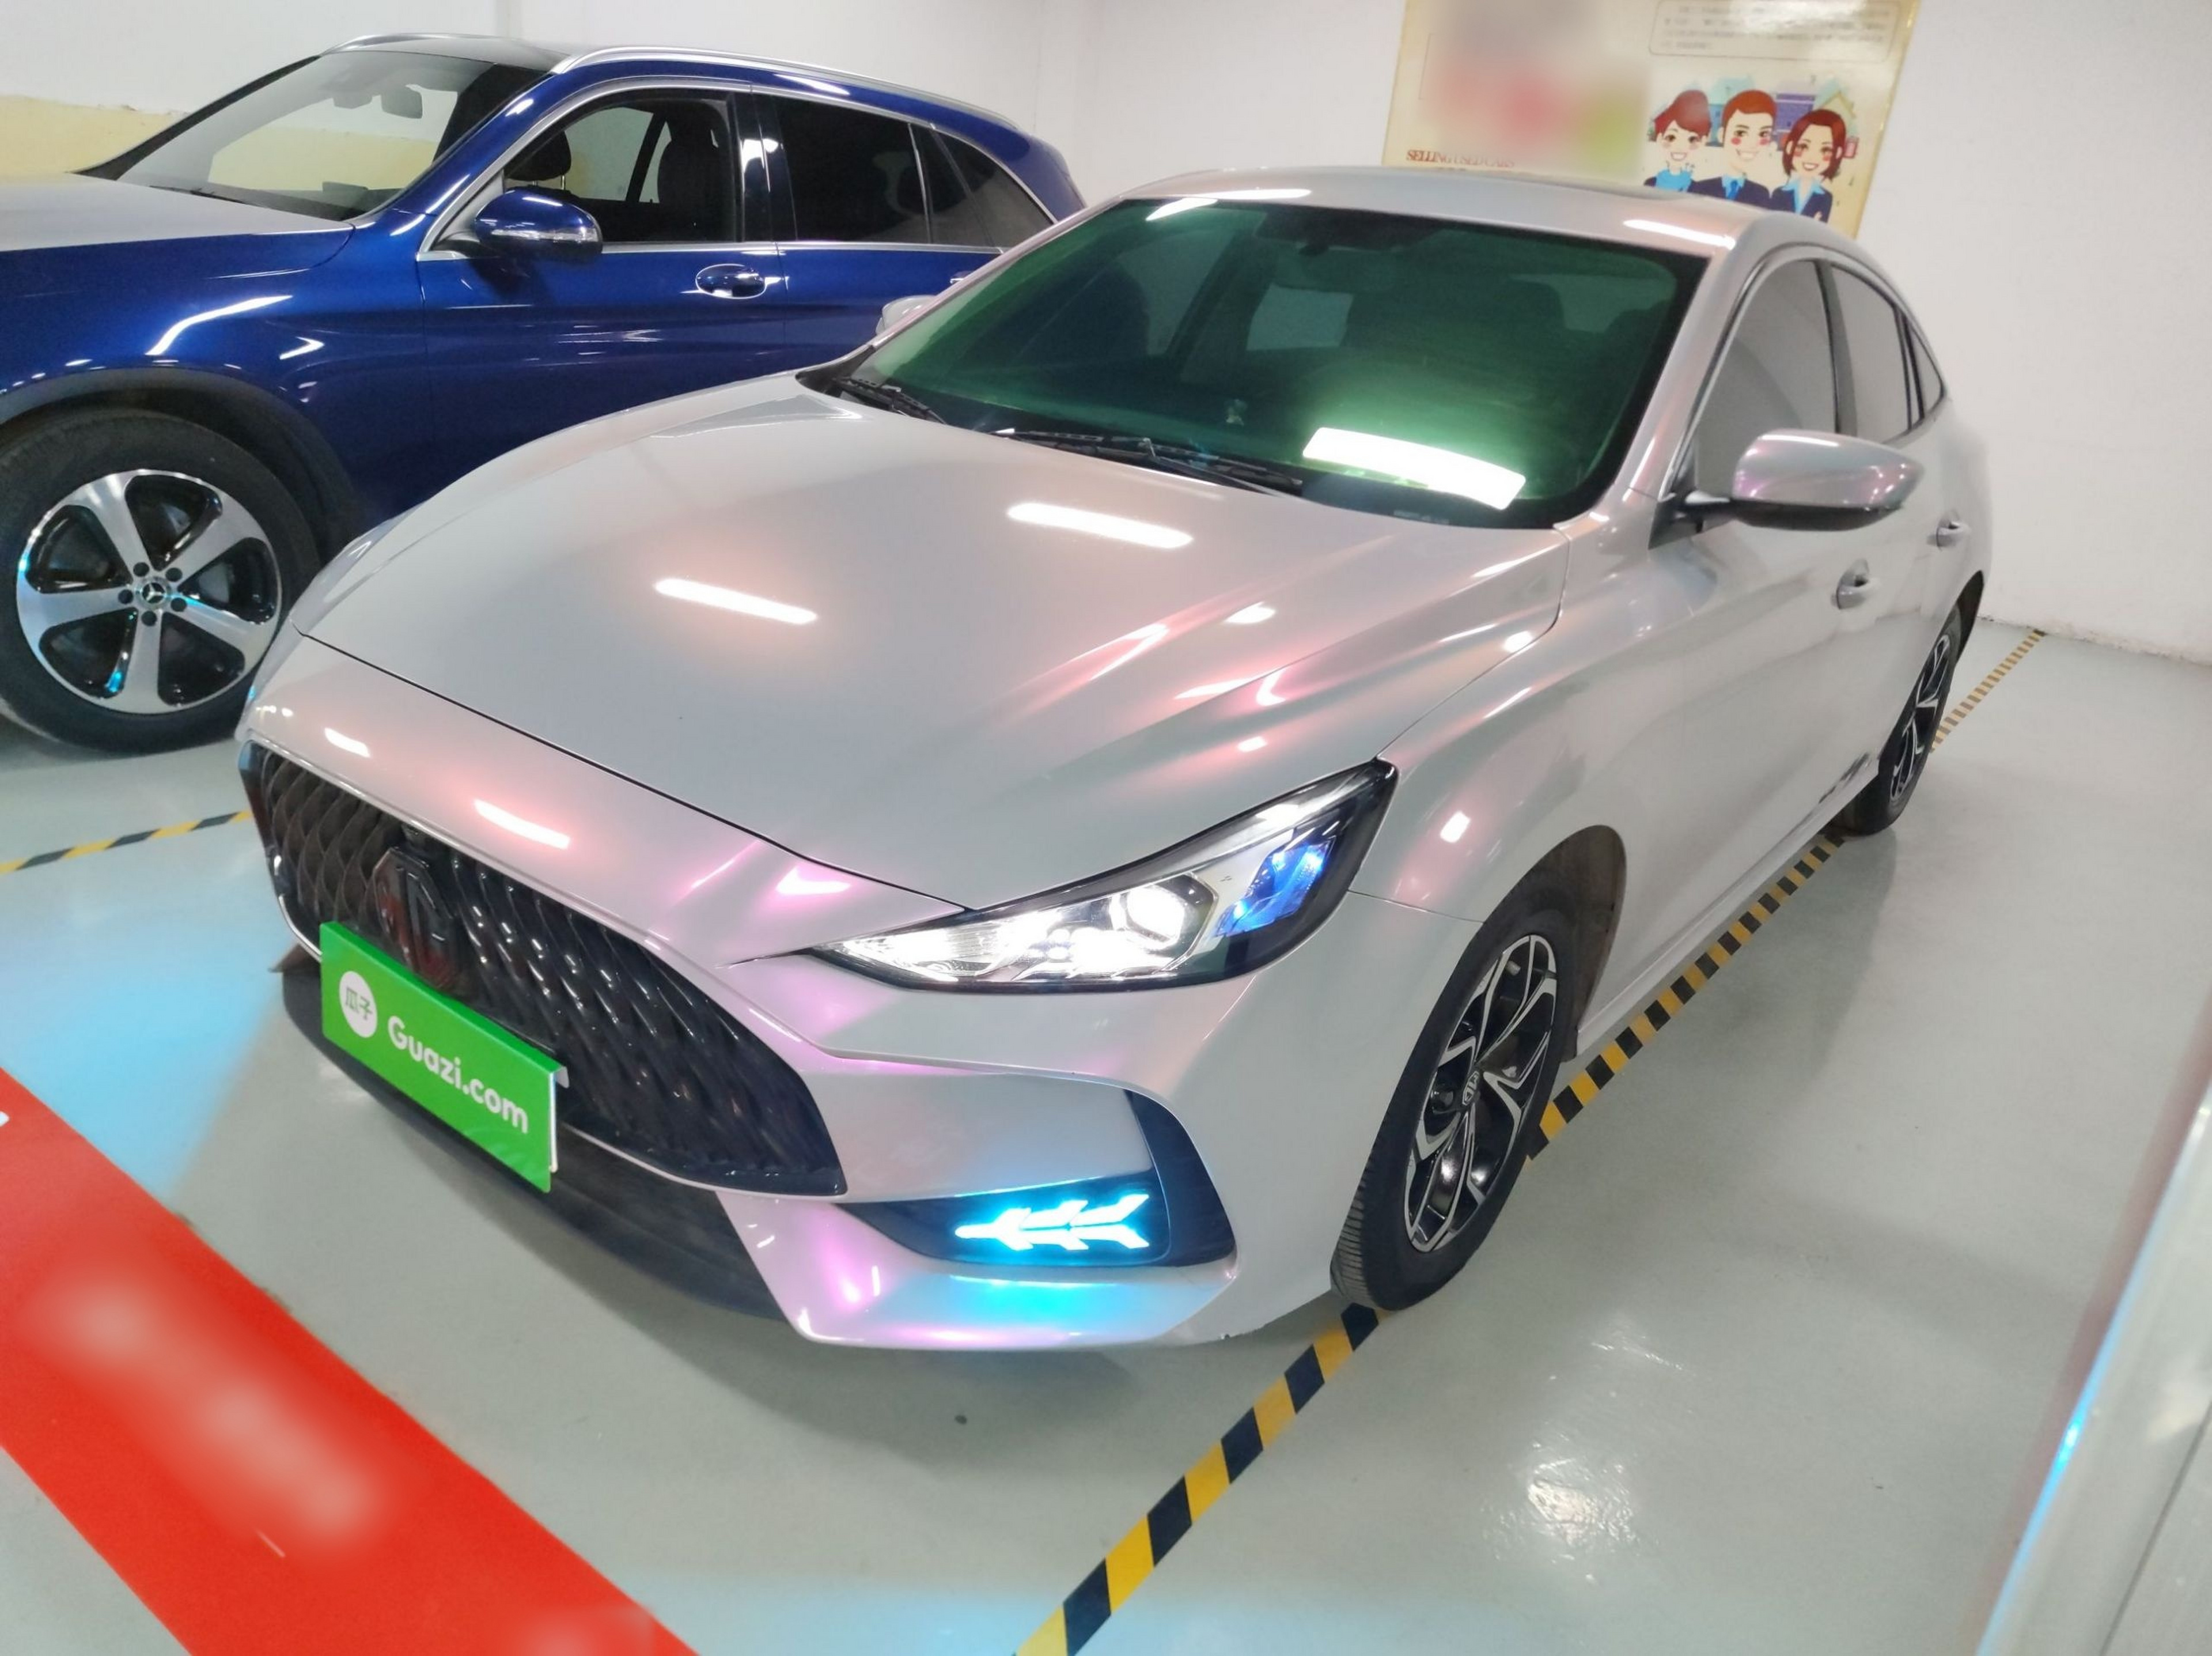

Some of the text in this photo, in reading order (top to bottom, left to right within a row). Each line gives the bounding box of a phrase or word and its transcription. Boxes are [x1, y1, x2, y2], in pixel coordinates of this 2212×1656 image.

[1406, 150, 1452, 164] SELLING
[346, 987, 373, 1020] 瓜子
[388, 1016, 528, 1133] Guazi.com
